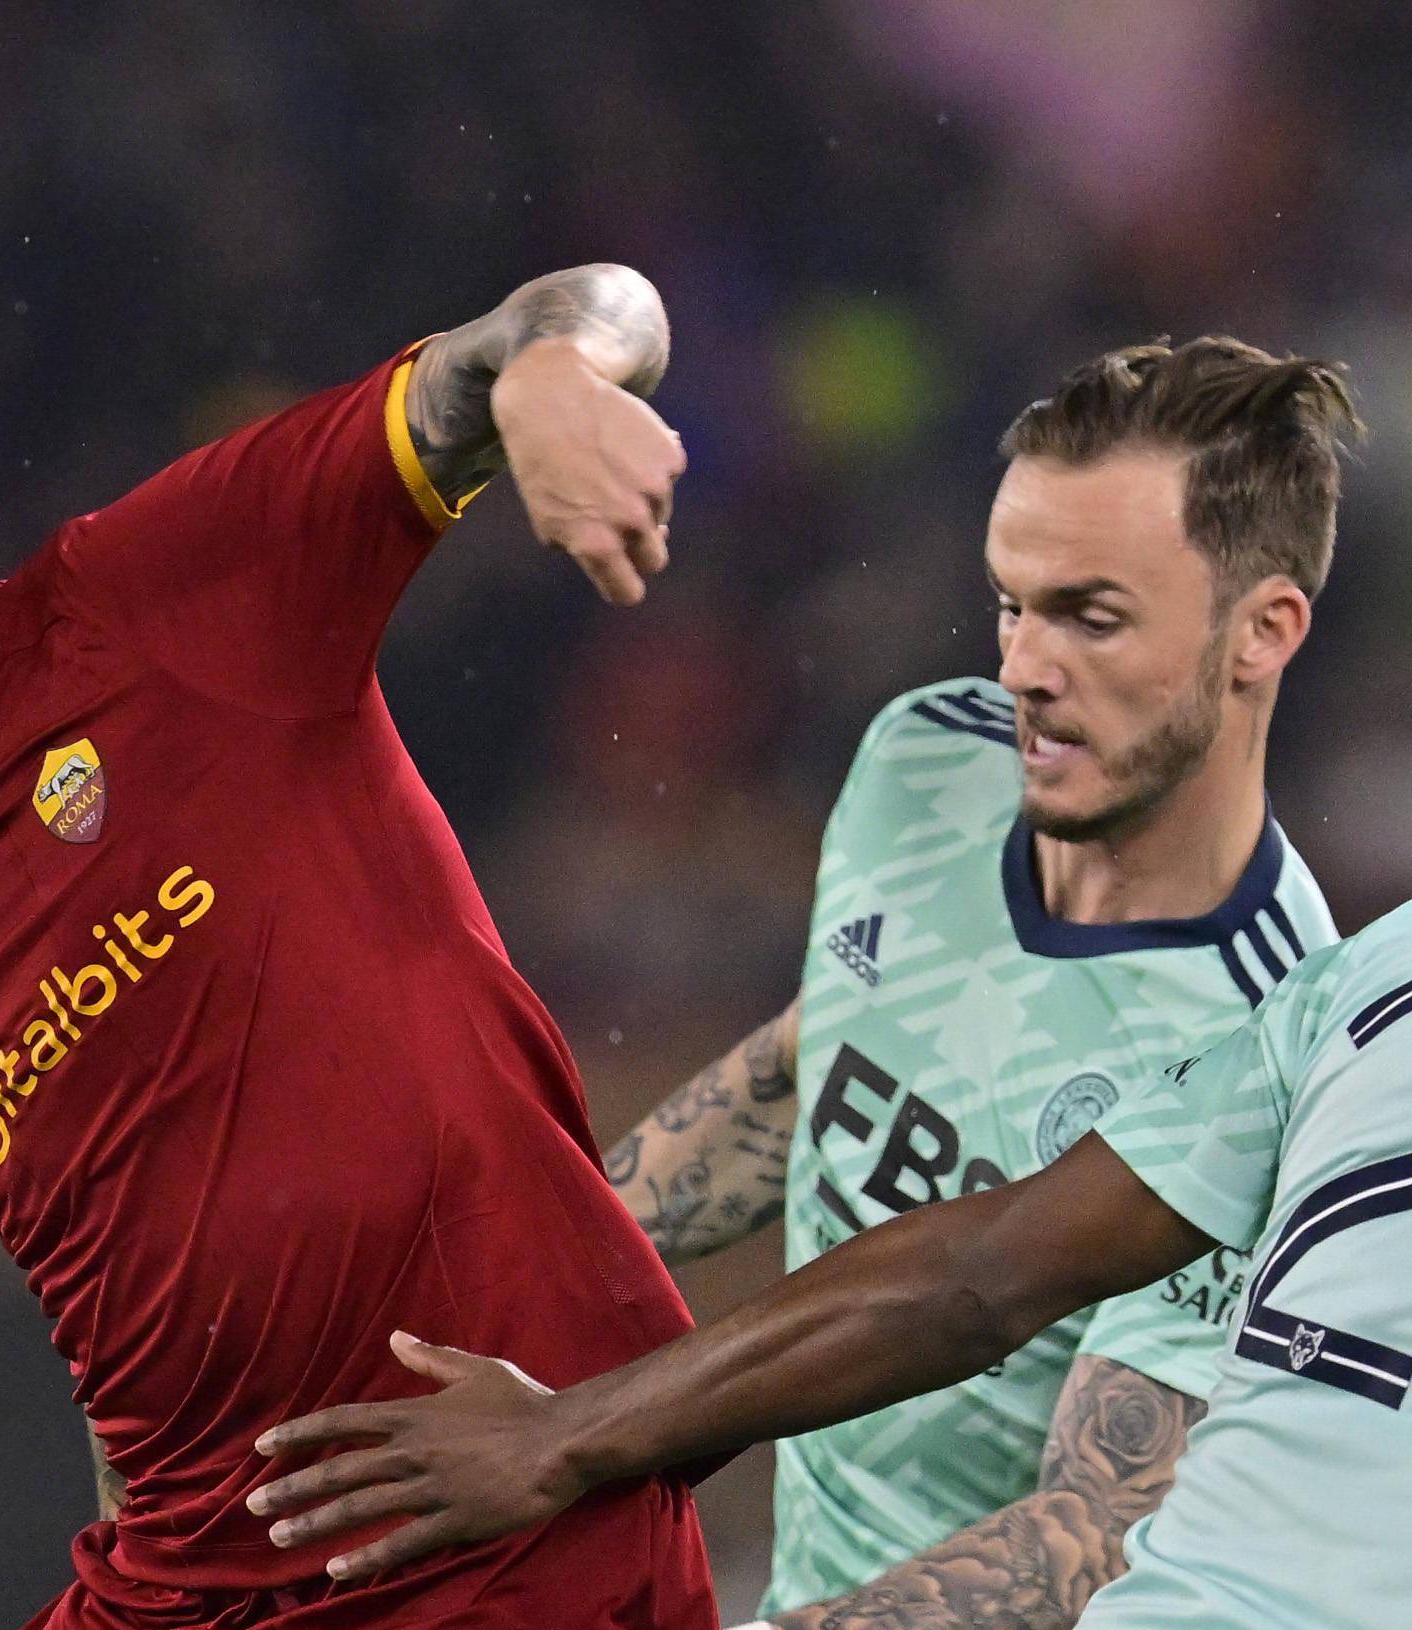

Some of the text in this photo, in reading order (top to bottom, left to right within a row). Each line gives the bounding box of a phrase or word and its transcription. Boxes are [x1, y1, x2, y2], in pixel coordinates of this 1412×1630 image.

[56, 784, 104, 835] ROMA
[77, 811, 97, 834] 1927
[1160, 1272, 1236, 1326] SAI
